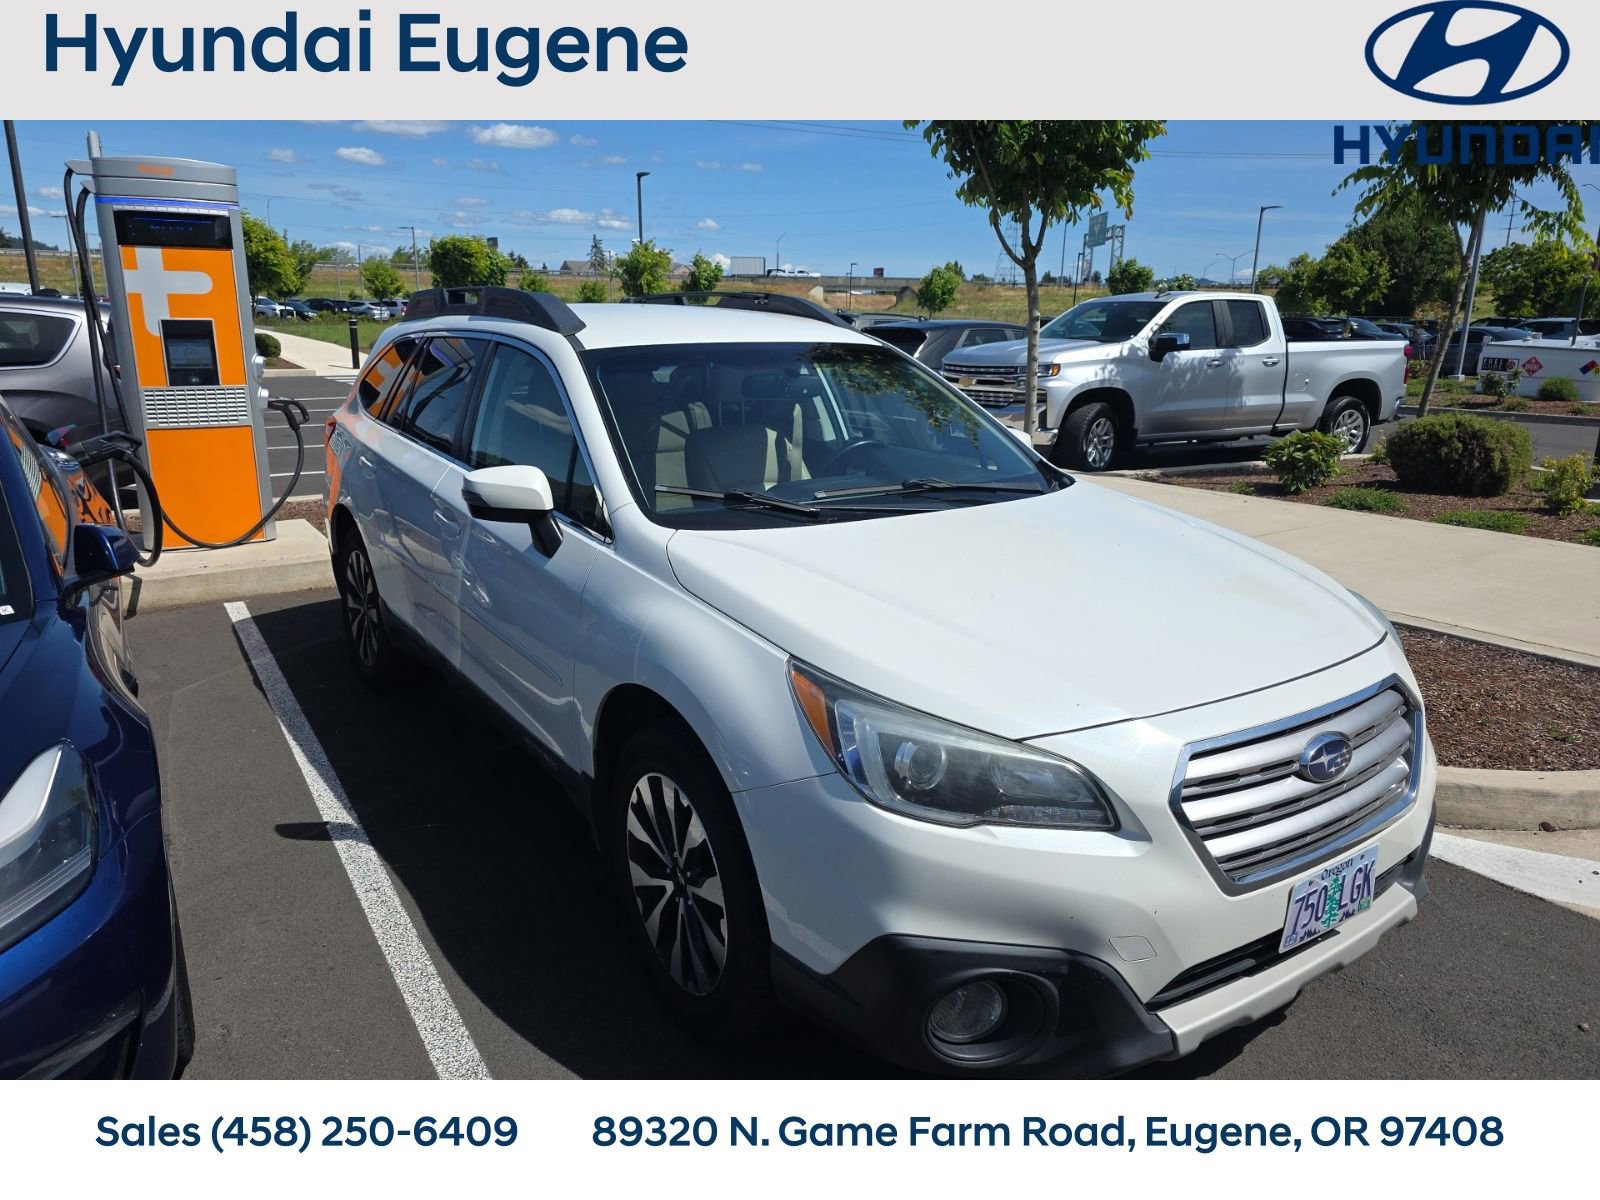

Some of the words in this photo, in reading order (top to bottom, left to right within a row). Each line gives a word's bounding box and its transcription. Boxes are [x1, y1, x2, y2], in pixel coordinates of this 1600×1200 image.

[1321, 857, 1354, 880] Oregon
[1292, 884, 1329, 935] 750
[1338, 859, 1376, 911] LGK
